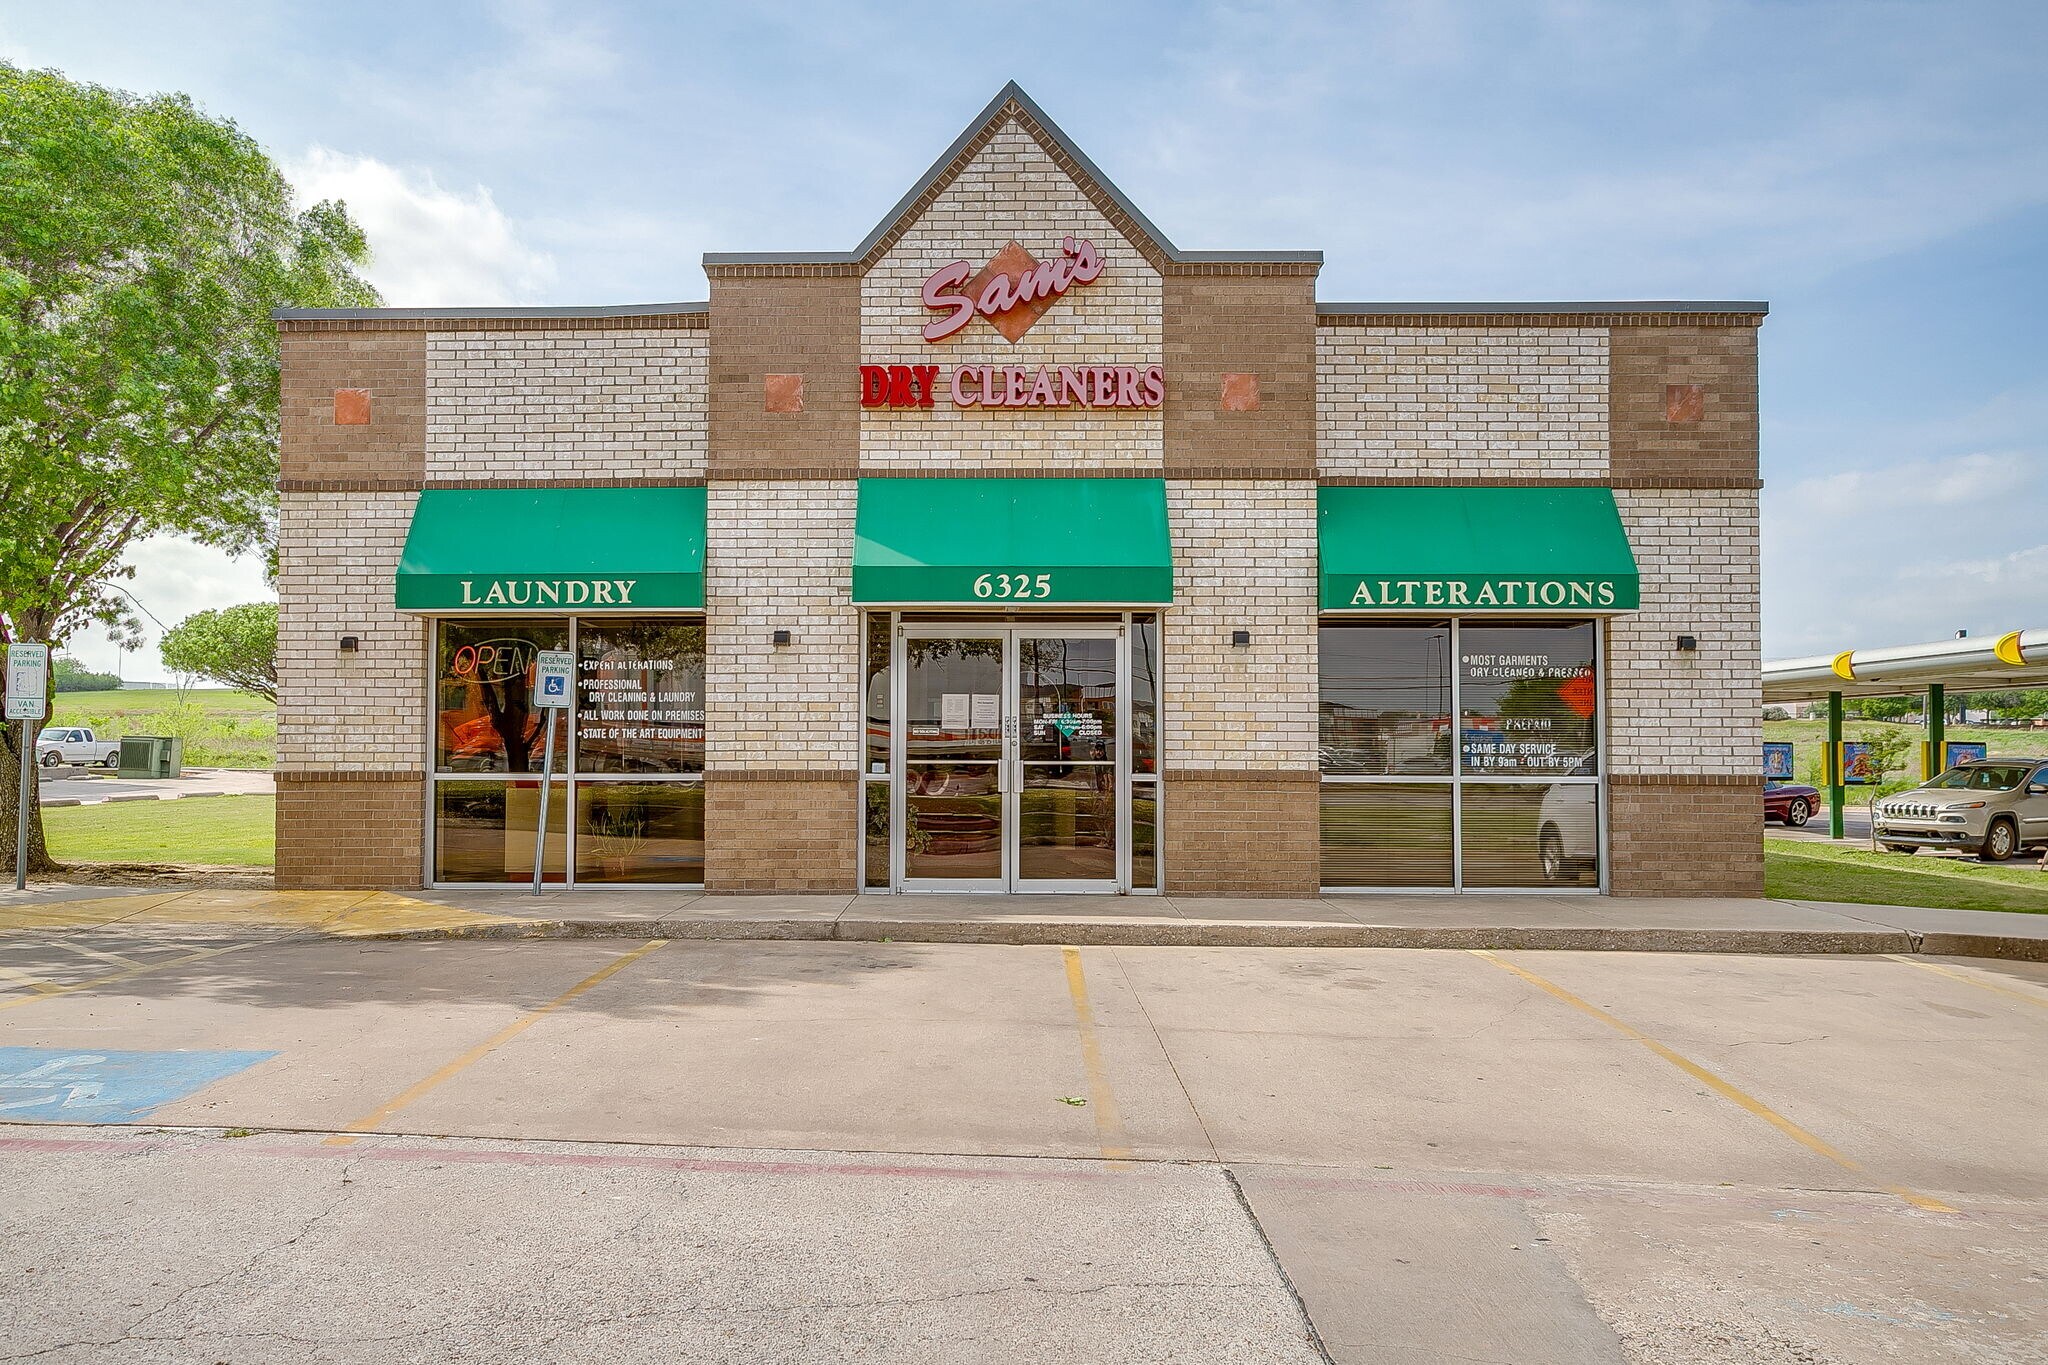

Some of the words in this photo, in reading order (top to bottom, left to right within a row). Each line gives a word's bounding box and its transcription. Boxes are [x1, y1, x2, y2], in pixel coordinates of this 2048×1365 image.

[922, 236, 1106, 342] Sam's
[859, 365, 940, 408] DRY
[951, 365, 1165, 408] CLEANERS
[973, 573, 1051, 598] 6325
[460, 580, 637, 604] LAUNDRY
[1350, 580, 1615, 606] ALTERATIONS
[11, 650, 44, 658] RESERVED
[454, 645, 533, 675] OPEN
[541, 656, 573, 665] RESERVED
[583, 660, 614, 670] EXPERT
[617, 660, 674, 670] ALTERATIONS
[1470, 655, 1496, 666] MOST
[1499, 655, 1548, 666] GARMENTS
[542, 665, 570, 674] PARKING
[1470, 667, 1488, 677] DRY
[1492, 667, 1535, 677] CLEANED
[1538, 667, 1545, 677] &
[1548, 667, 1591, 678] PRESSED
[583, 679, 642, 690] PROFESSIONAL
[589, 692, 606, 702] DRY
[608, 692, 647, 702] CLEANING
[649, 692, 656, 702] &
[658, 692, 696, 702] LAUNDRY
[583, 710, 599, 721] ALL
[601, 710, 625, 721] WORK
[628, 710, 649, 721] DONE
[651, 710, 663, 721] ON
[665, 710, 705, 721] PREMISES
[583, 728, 606, 739] STATE
[608, 728, 619, 739] OF
[622, 728, 637, 739] THE
[640, 728, 655, 739] ART
[656, 728, 703, 739] EQUIPMENT
[1471, 743, 1496, 754] SAME
[1499, 743, 1516, 754] DAY
[1519, 743, 1556, 754] SERVICE
[1471, 756, 1480, 767] IN
[1483, 756, 1496, 767] BY
[1498, 756, 1517, 767] 9am
[1527, 756, 1545, 767] OUT
[1548, 756, 1560, 767] BY
[1562, 756, 1583, 767] 5PM
